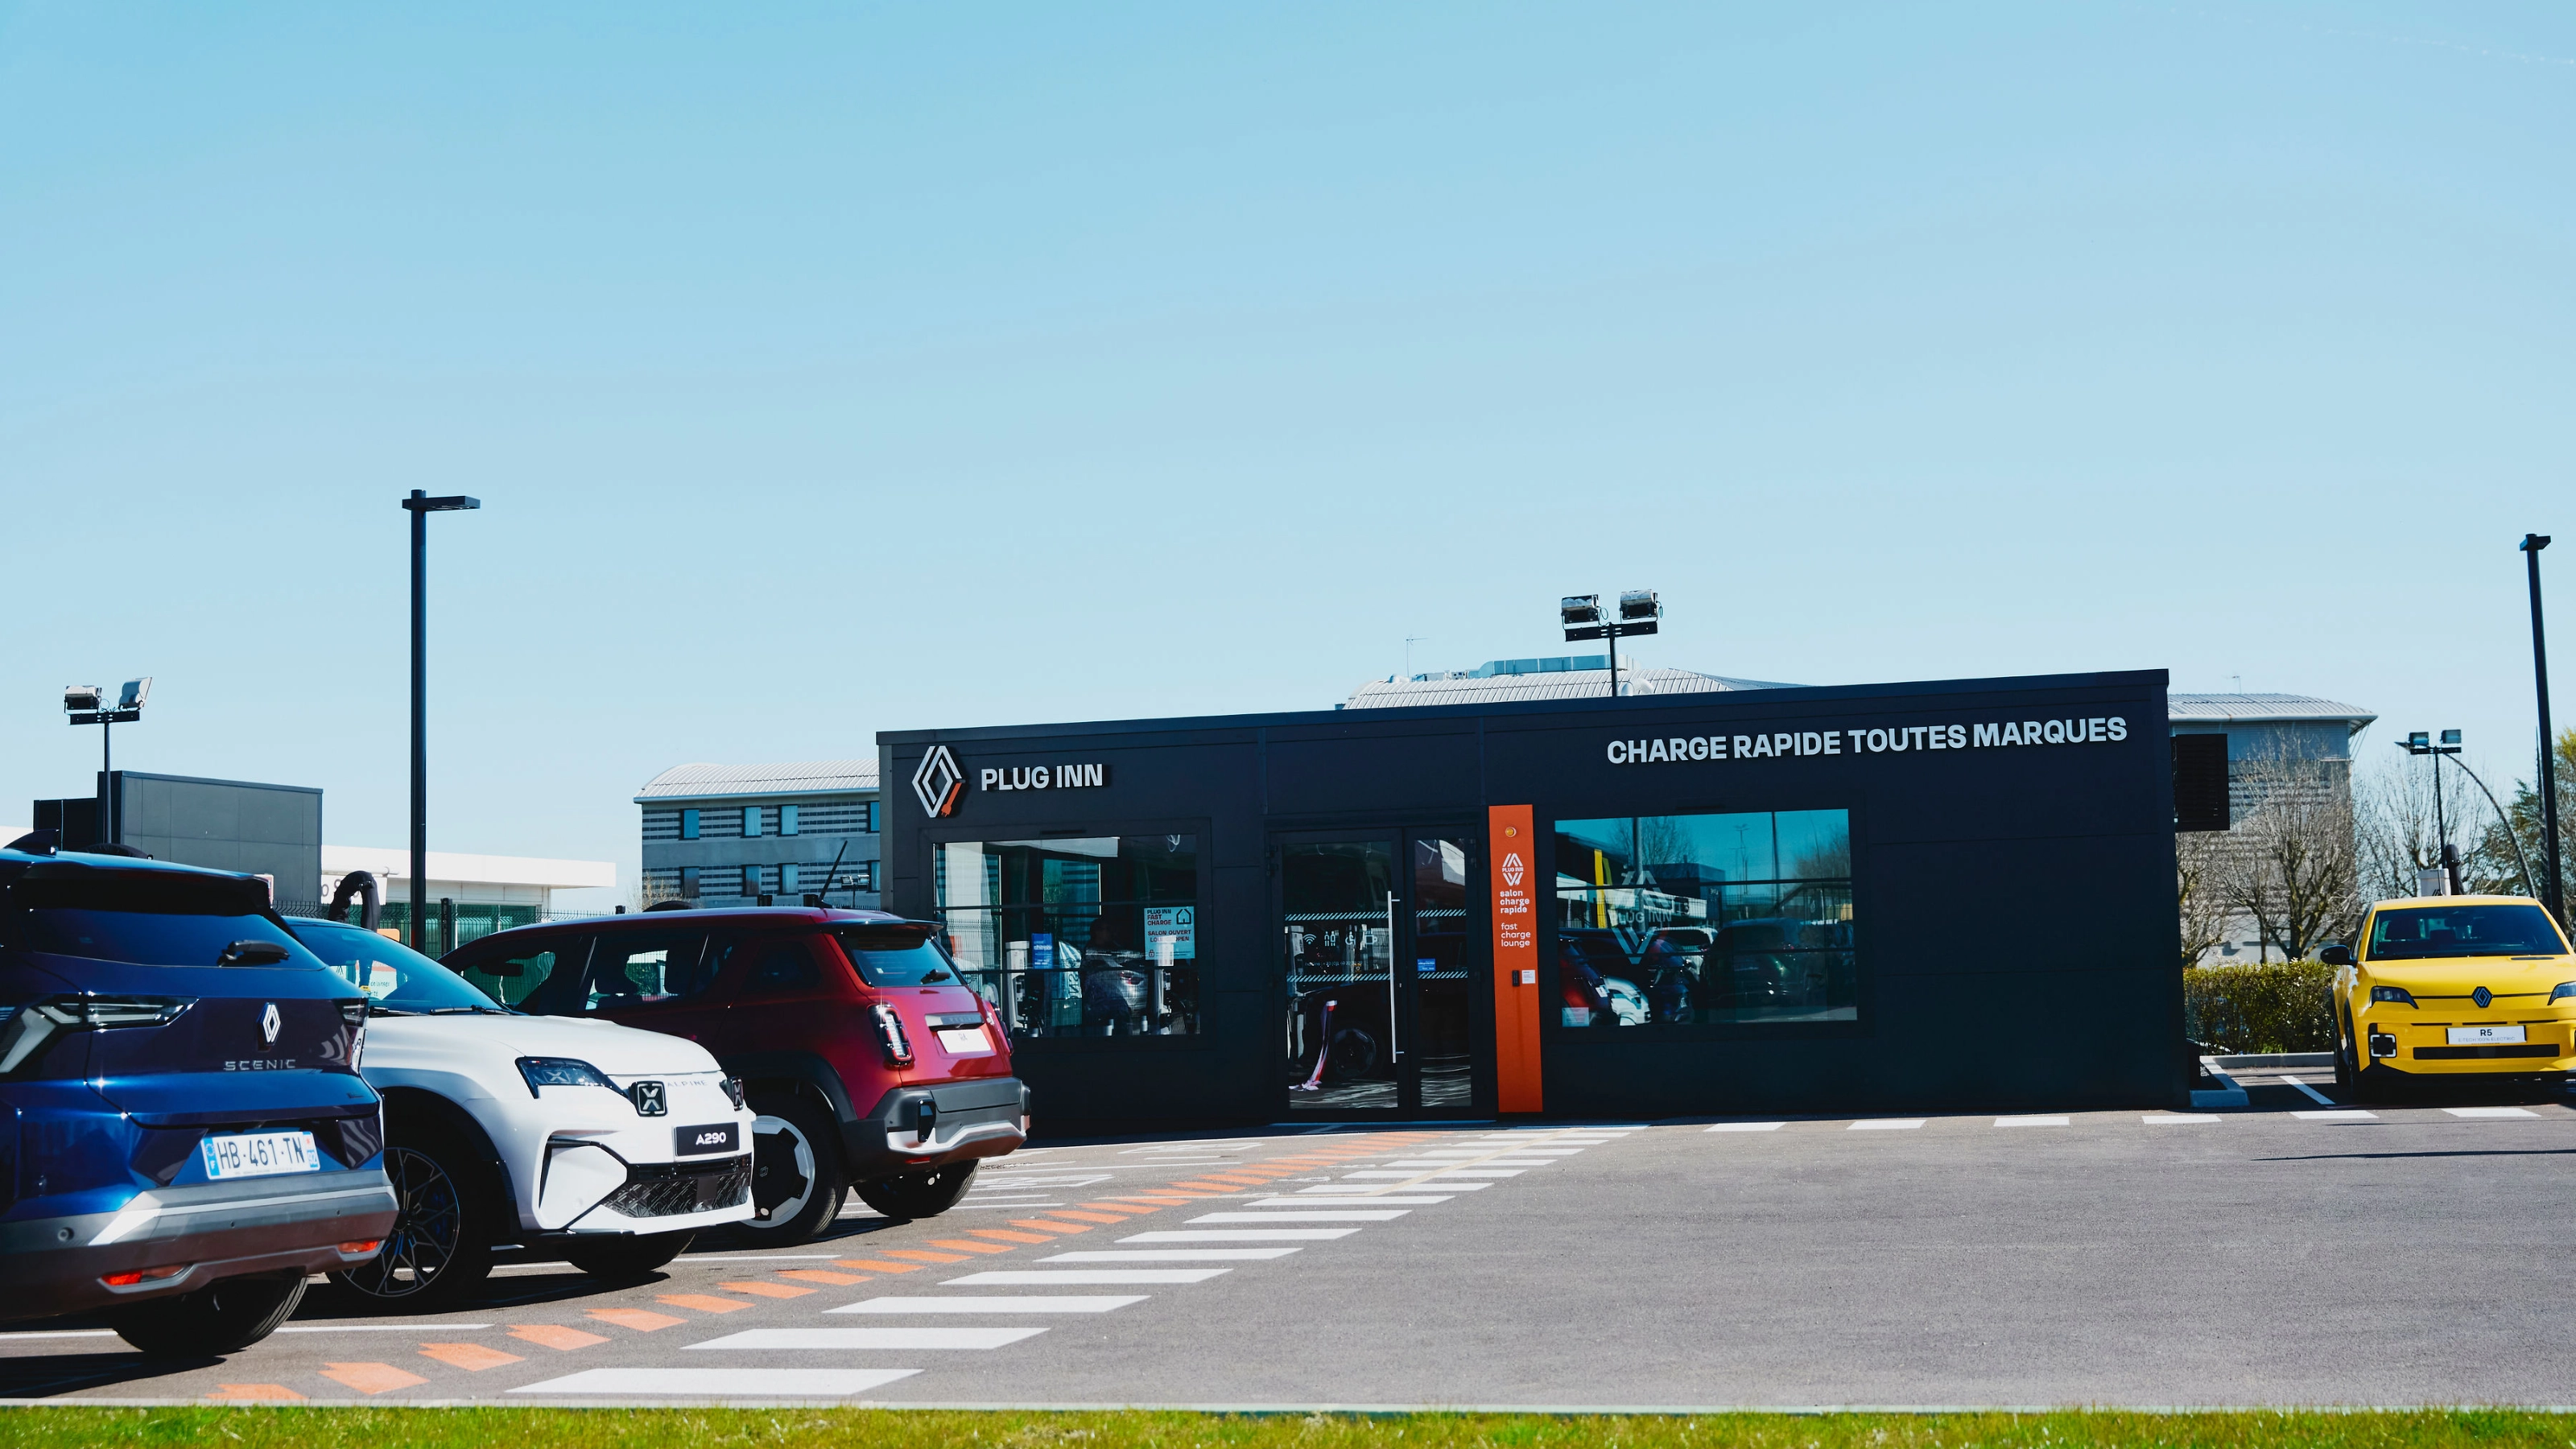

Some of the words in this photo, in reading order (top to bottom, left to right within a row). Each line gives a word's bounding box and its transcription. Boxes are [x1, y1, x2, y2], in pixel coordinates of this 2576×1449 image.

[1607, 736, 1728, 764] CHARGE
[1732, 730, 1841, 758] RAPIDE
[1847, 724, 1967, 753] TOUTES
[1973, 716, 2128, 748] MARQUES
[980, 766, 1050, 791] PLUG
[1056, 764, 1103, 788] INN
[1500, 898, 1530, 906] charge
[1500, 906, 1527, 914] rapide
[1612, 912, 1645, 926] LUG
[1649, 910, 1673, 923] INN
[1501, 931, 1531, 939] charge
[1501, 939, 1531, 947] lounge
[2479, 1029, 2492, 1037] R5
[223, 1059, 296, 1071] SCENIC
[667, 1080, 708, 1088] ALPINE
[696, 1132, 726, 1146] A290
